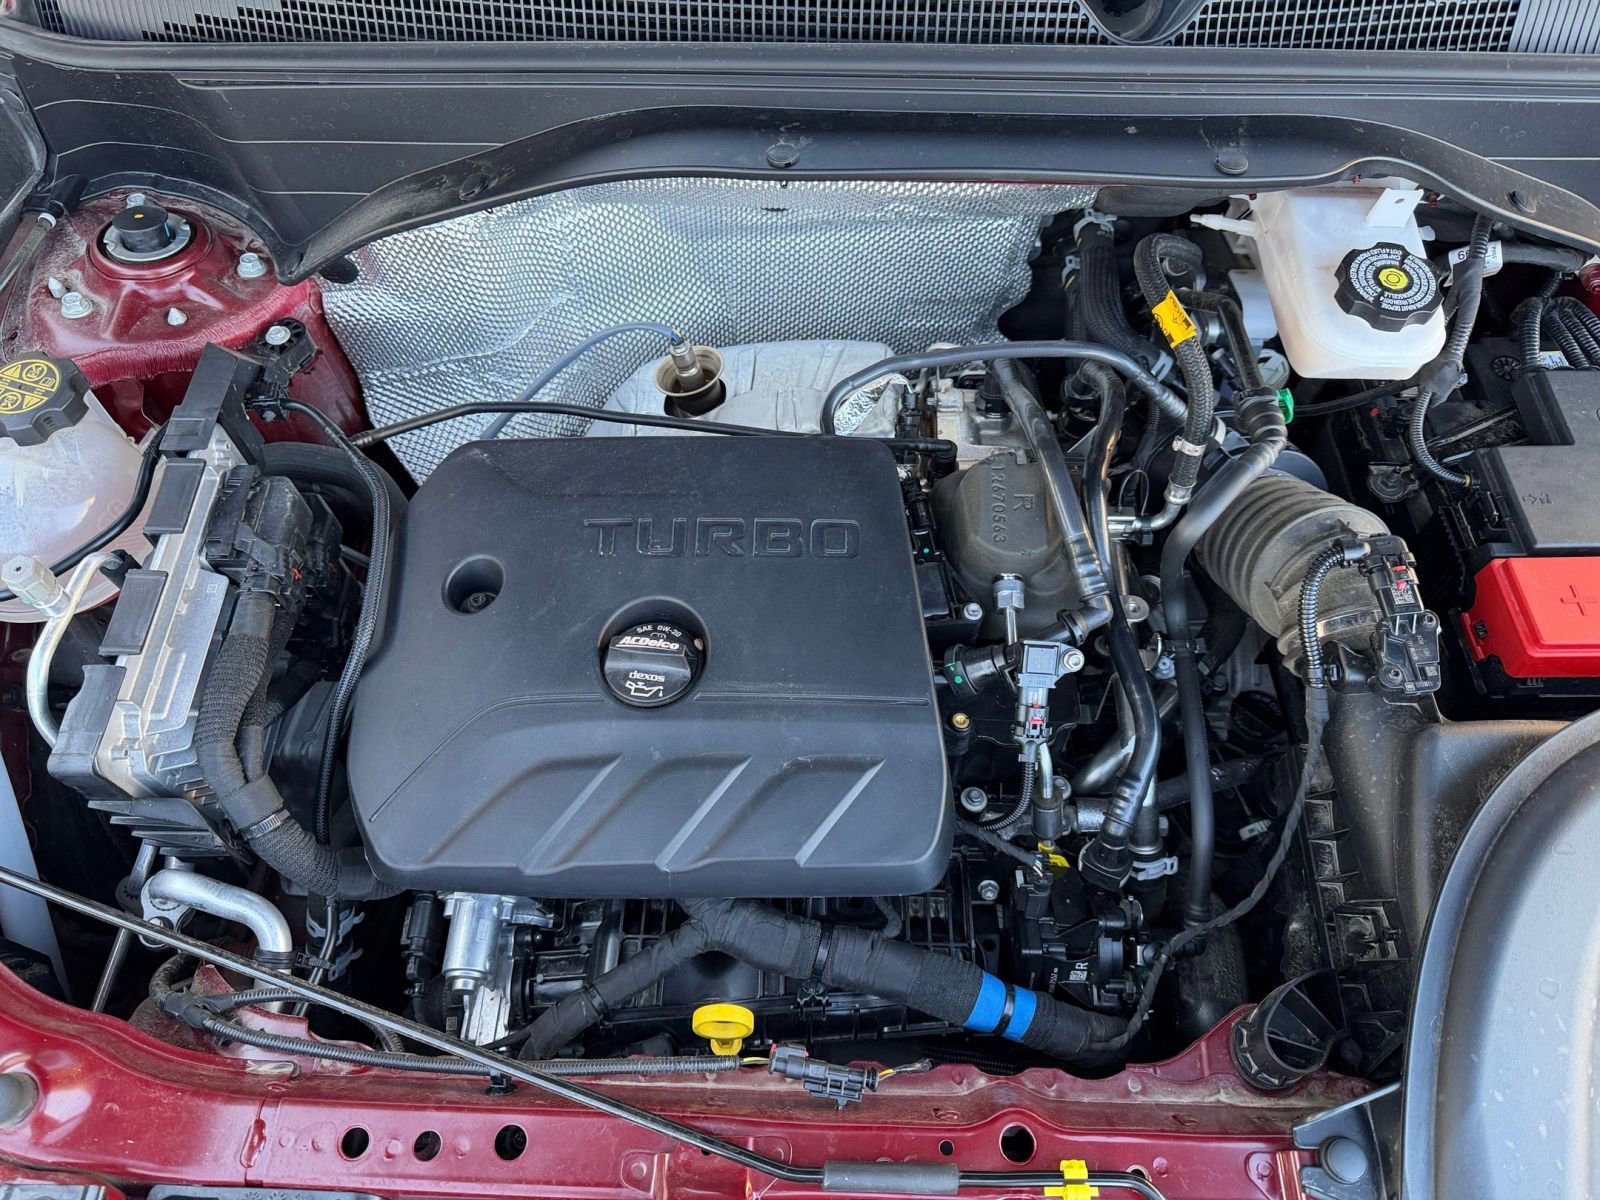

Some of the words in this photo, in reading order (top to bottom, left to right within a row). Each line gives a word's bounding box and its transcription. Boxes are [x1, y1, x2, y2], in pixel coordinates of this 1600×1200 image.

[991, 465, 1007, 544] 12670563
[584, 518, 861, 559] TURBO
[637, 625, 653, 633] SAE
[657, 625, 682, 638] 0W-20
[618, 635, 680, 650] ACDelco
[628, 670, 666, 682] dexos
[1075, 962, 1089, 970] R
